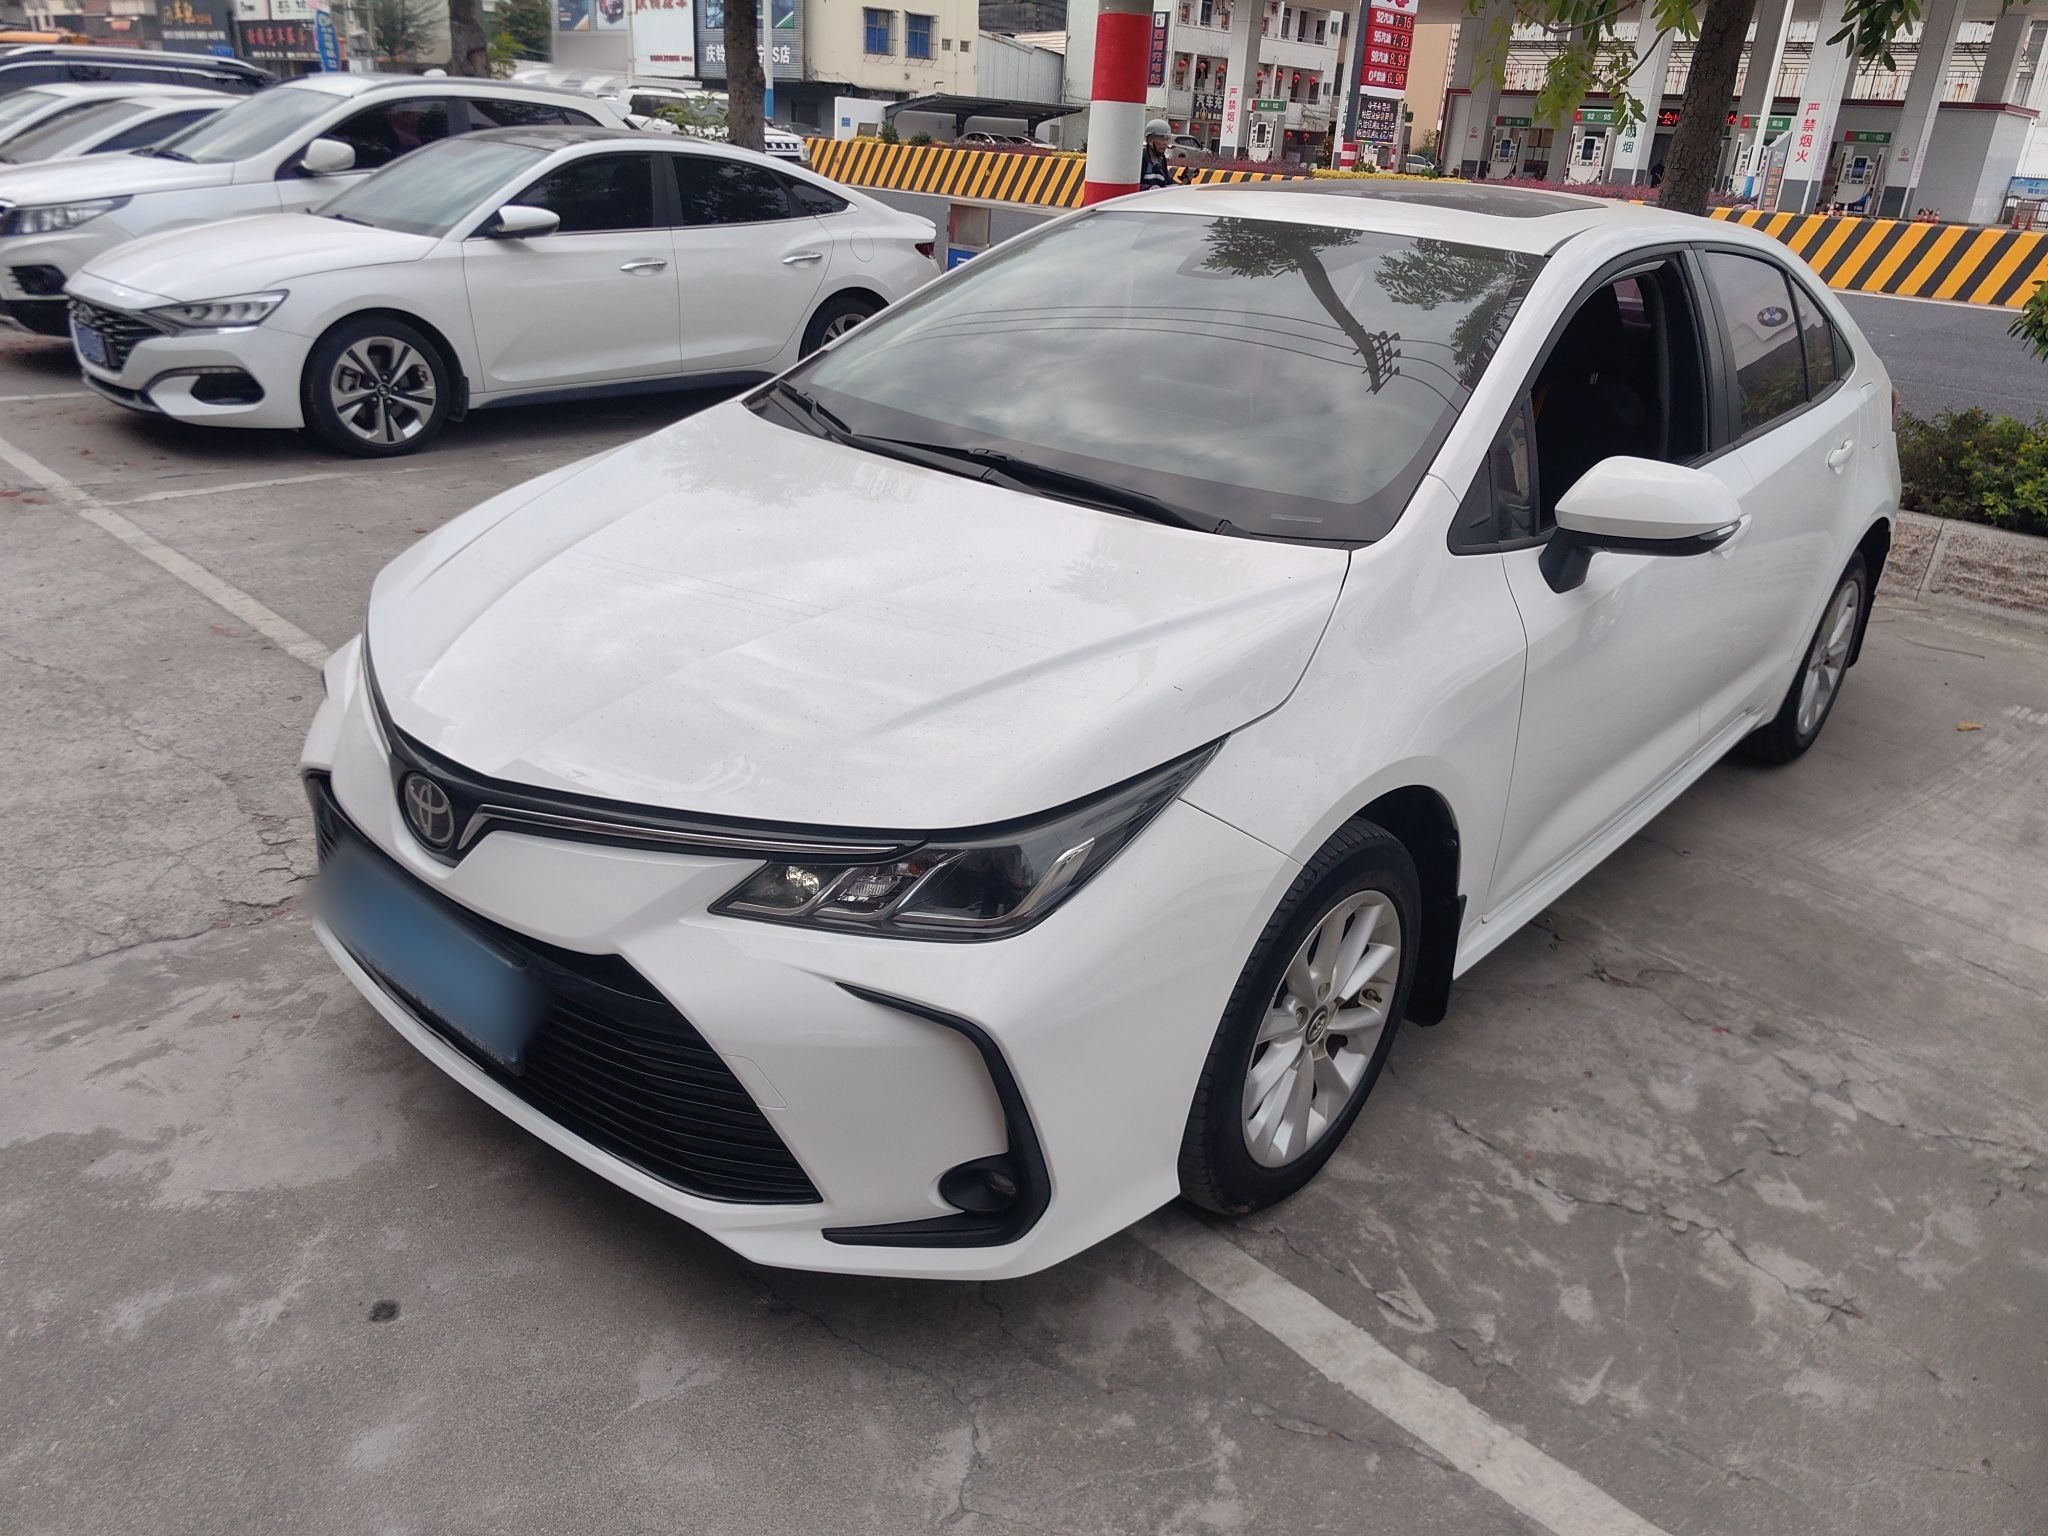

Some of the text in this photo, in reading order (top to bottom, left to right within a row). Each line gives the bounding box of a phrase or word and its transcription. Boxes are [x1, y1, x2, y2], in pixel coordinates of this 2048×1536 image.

[1226, 87, 1238, 134] 严禁烟火
[1603, 113, 1612, 121] 95
[1795, 102, 1821, 163] 严禁烟火
